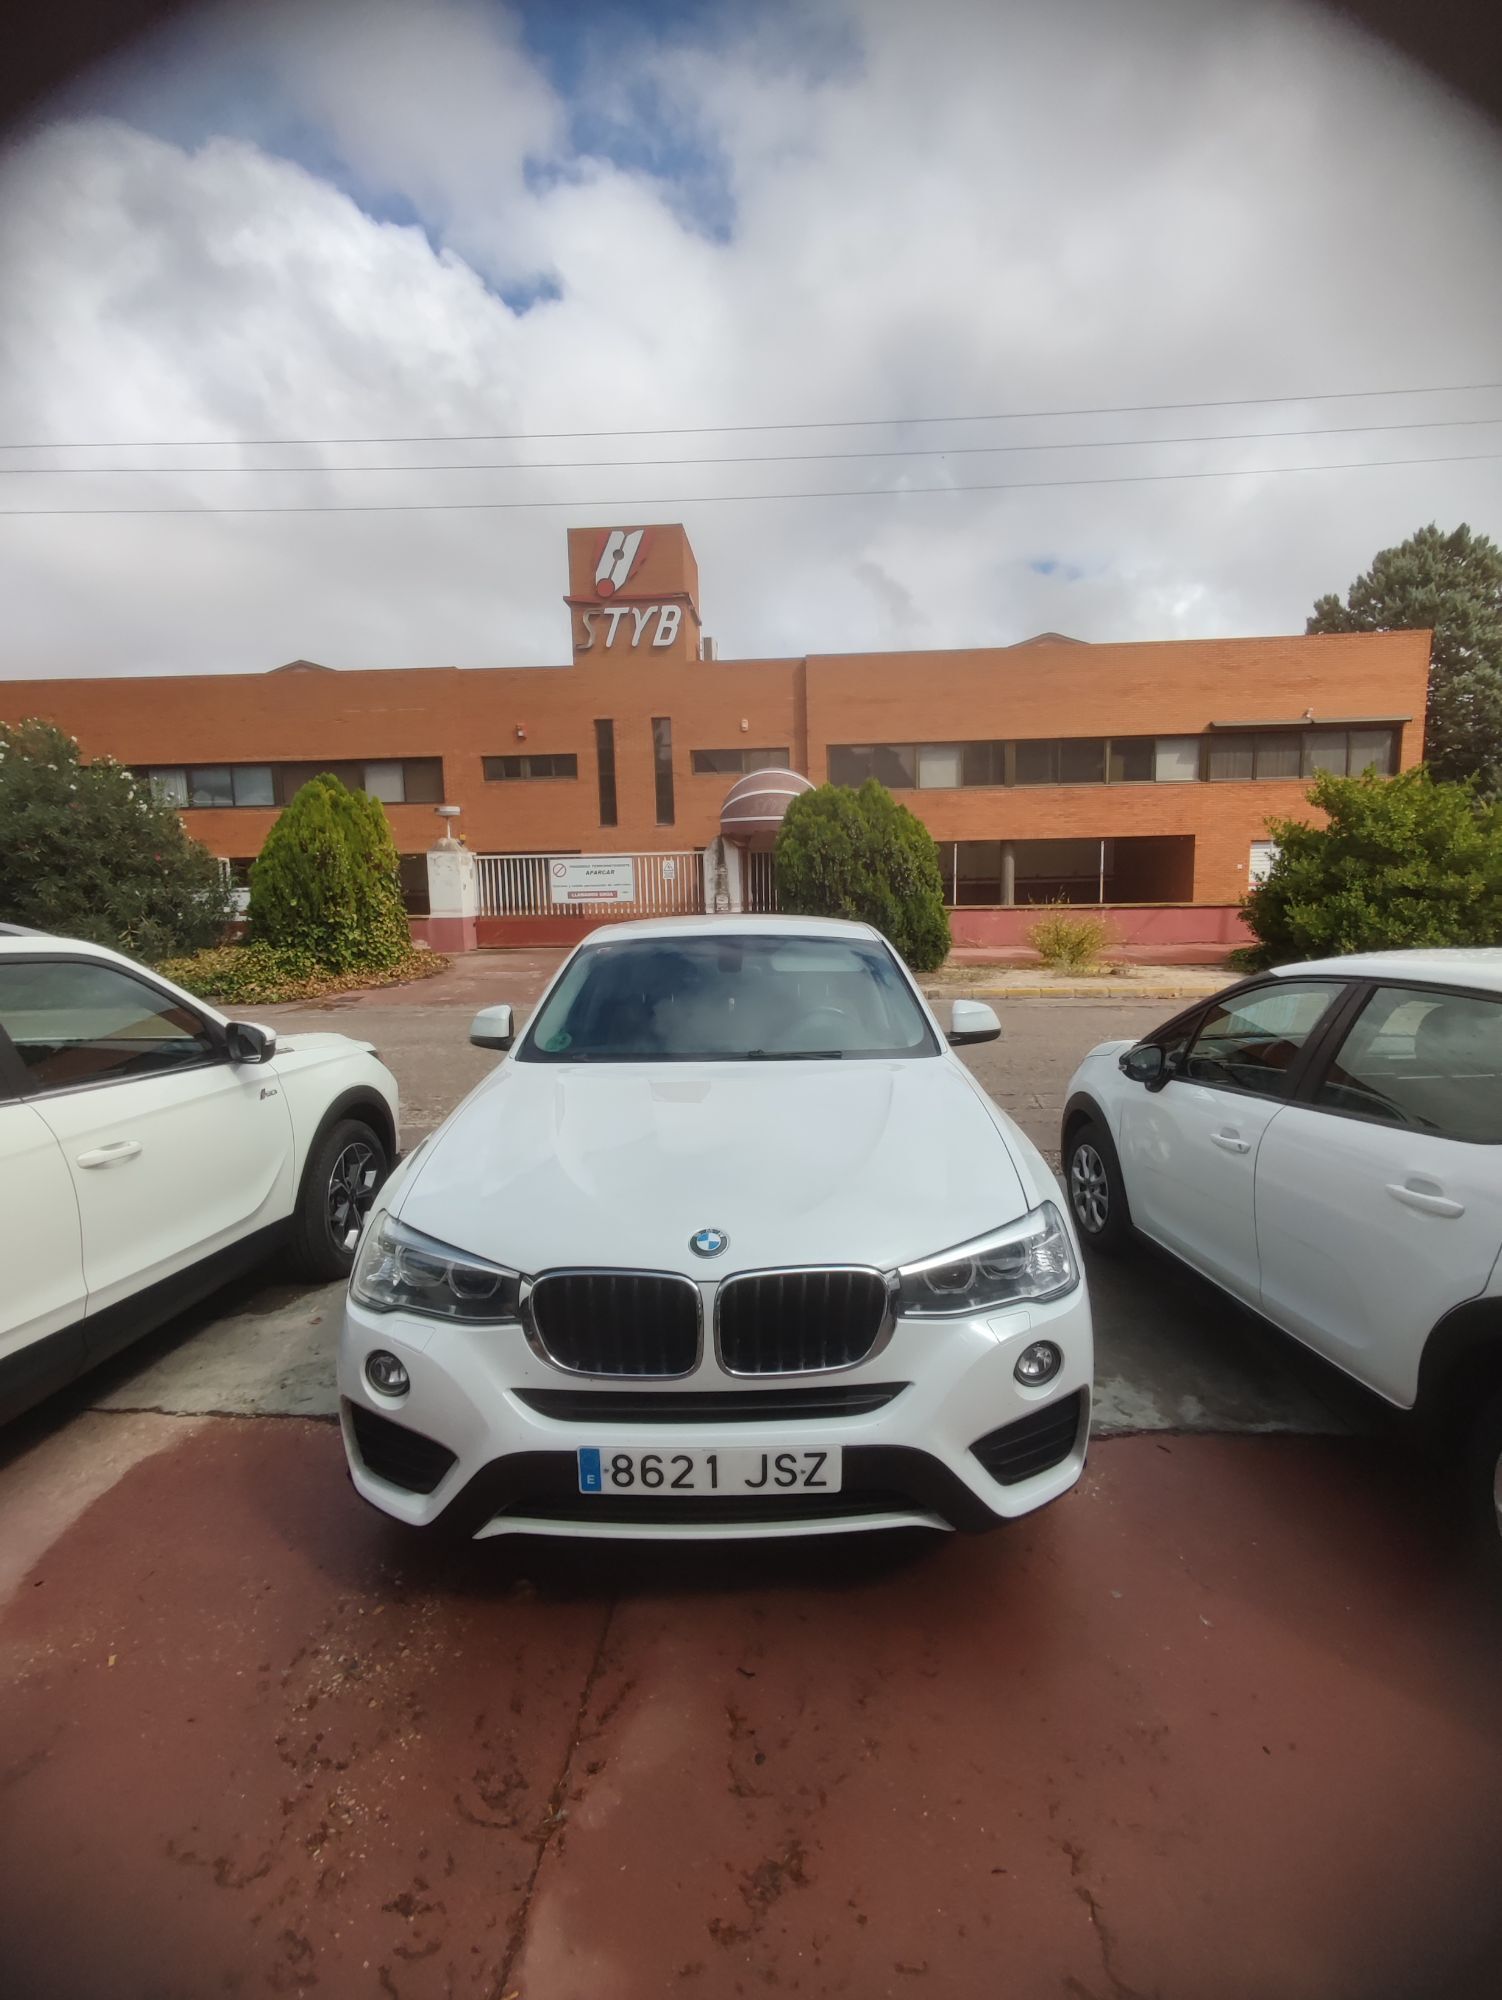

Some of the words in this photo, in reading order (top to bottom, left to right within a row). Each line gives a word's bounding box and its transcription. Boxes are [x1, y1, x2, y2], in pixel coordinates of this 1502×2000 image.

[575, 605, 682, 649] STYB
[587, 1474, 595, 1484] E
[611, 1454, 718, 1489] 8621
[744, 1452, 828, 1488] JSZ
